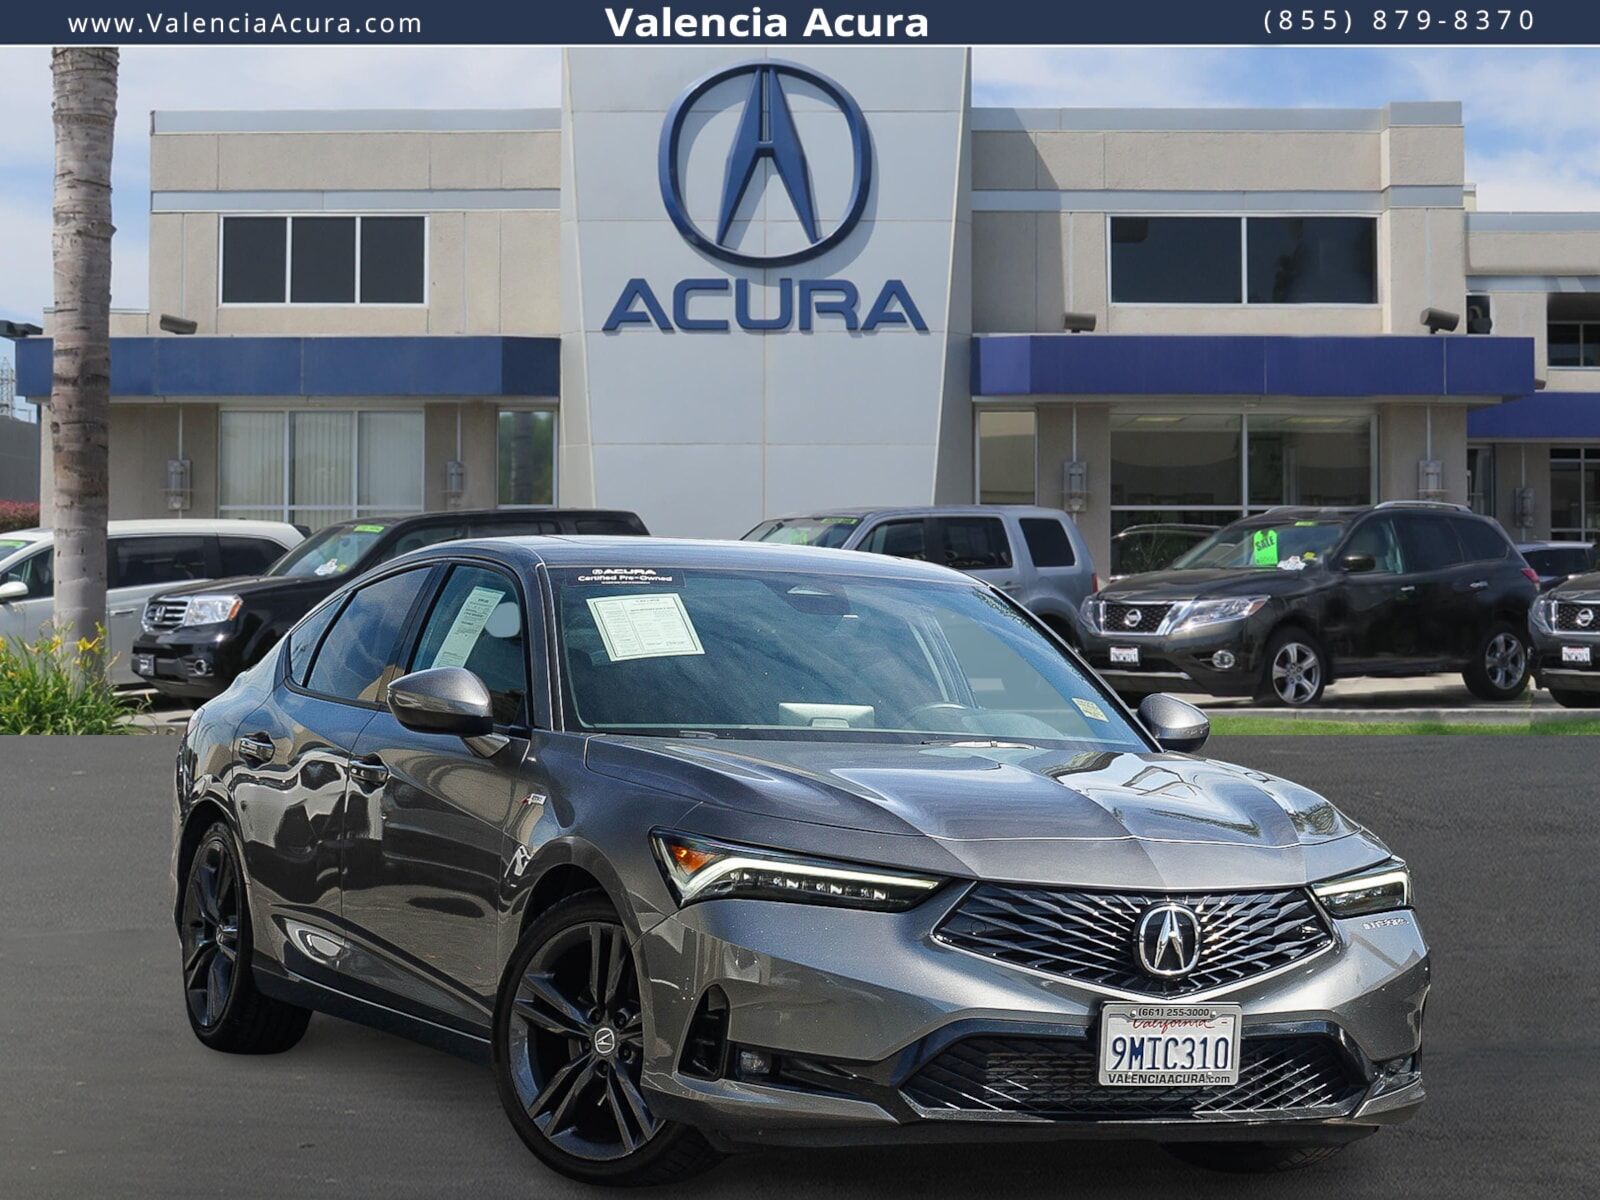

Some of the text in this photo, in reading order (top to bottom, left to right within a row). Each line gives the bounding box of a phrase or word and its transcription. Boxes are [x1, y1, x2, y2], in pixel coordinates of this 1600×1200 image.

[602, 278, 929, 333] ACURA
[1138, 1008, 1210, 1017] (661) 255-3000
[1111, 1037, 1229, 1070] 9MIC310
[1108, 1074, 1231, 1084] VALENCIAACURA.com
